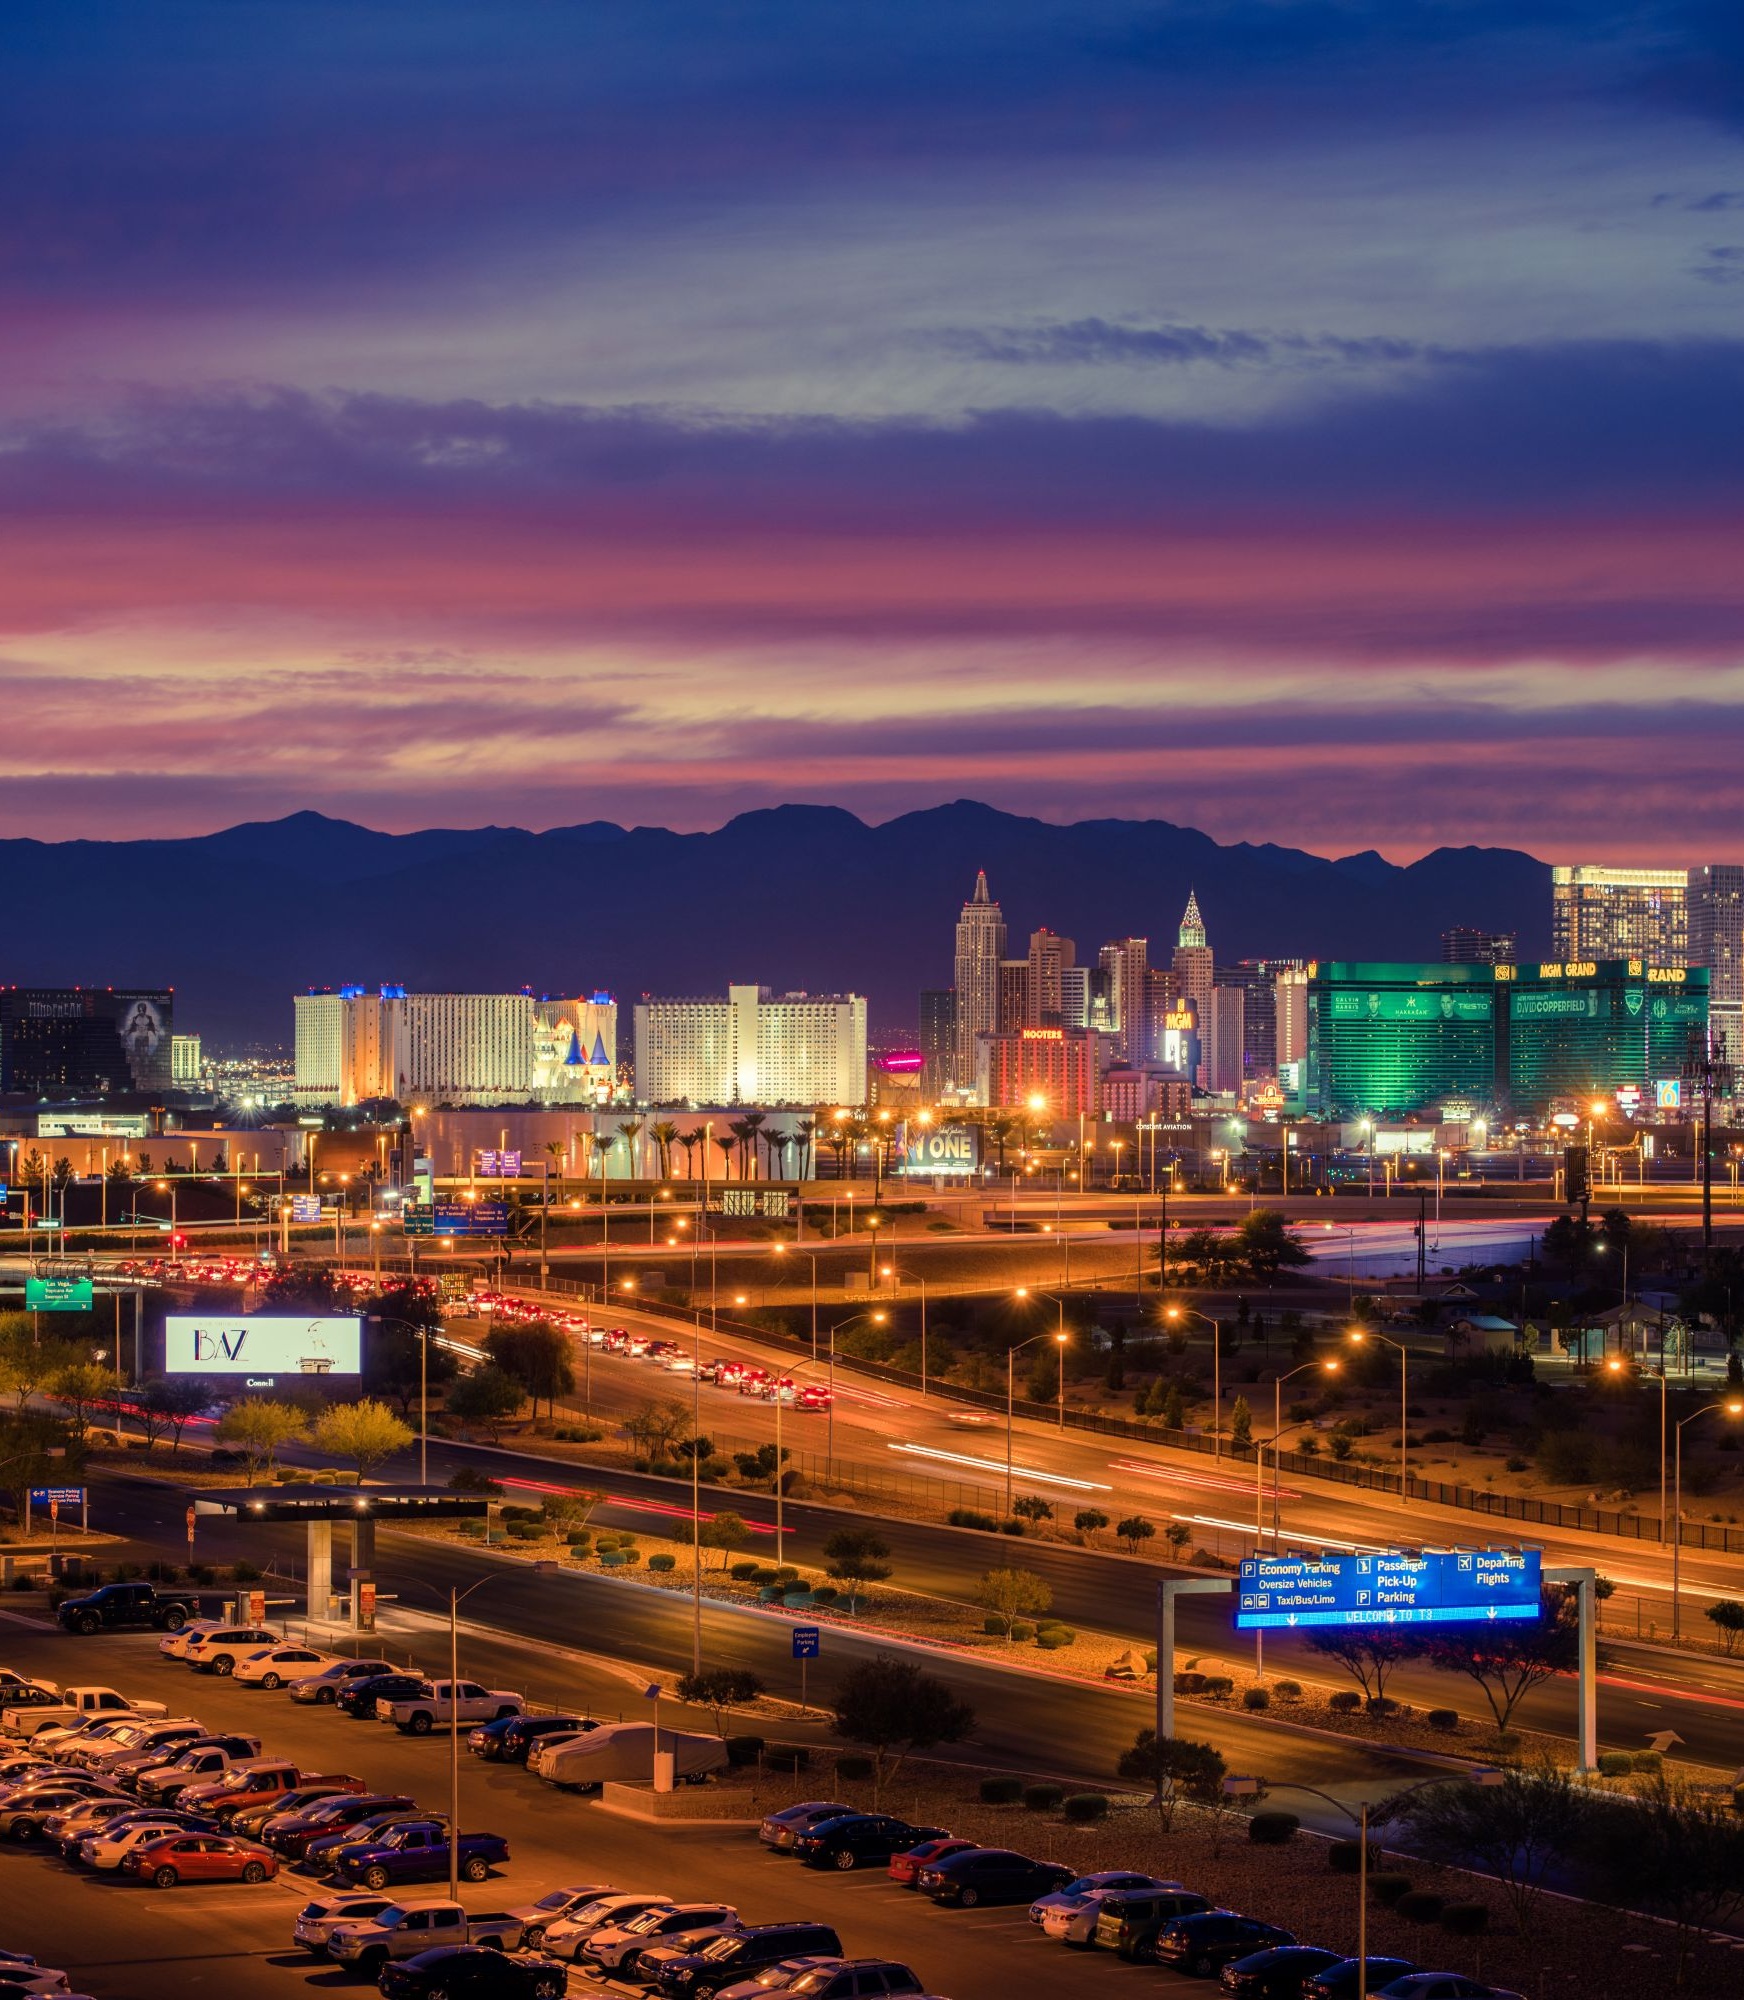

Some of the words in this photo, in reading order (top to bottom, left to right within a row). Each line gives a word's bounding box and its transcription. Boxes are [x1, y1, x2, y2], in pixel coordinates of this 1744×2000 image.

[1540, 964, 1562, 978] MGM
[1565, 962, 1596, 976] GRAND
[1166, 1013, 1192, 1030] MGM
[1023, 1029, 1063, 1039] HOOTERS
[1661, 1080, 1678, 1107] 6
[929, 1136, 972, 1159] ONE
[1258, 1563, 1303, 1575] Economy
[1305, 1562, 1341, 1575] Parking
[1377, 1560, 1428, 1572] Passenger
[1476, 1557, 1526, 1570] Departing
[1258, 1578, 1295, 1590] Oversize
[1297, 1577, 1333, 1588] Vehicles
[1377, 1575, 1418, 1588] Pick-Up
[1476, 1572, 1510, 1586] Flights
[1276, 1594, 1336, 1606] Taxi/Bus/Limo
[1377, 1591, 1415, 1605] Parking
[1399, 1609, 1413, 1620] TO
[1418, 1608, 1433, 1619] T3
